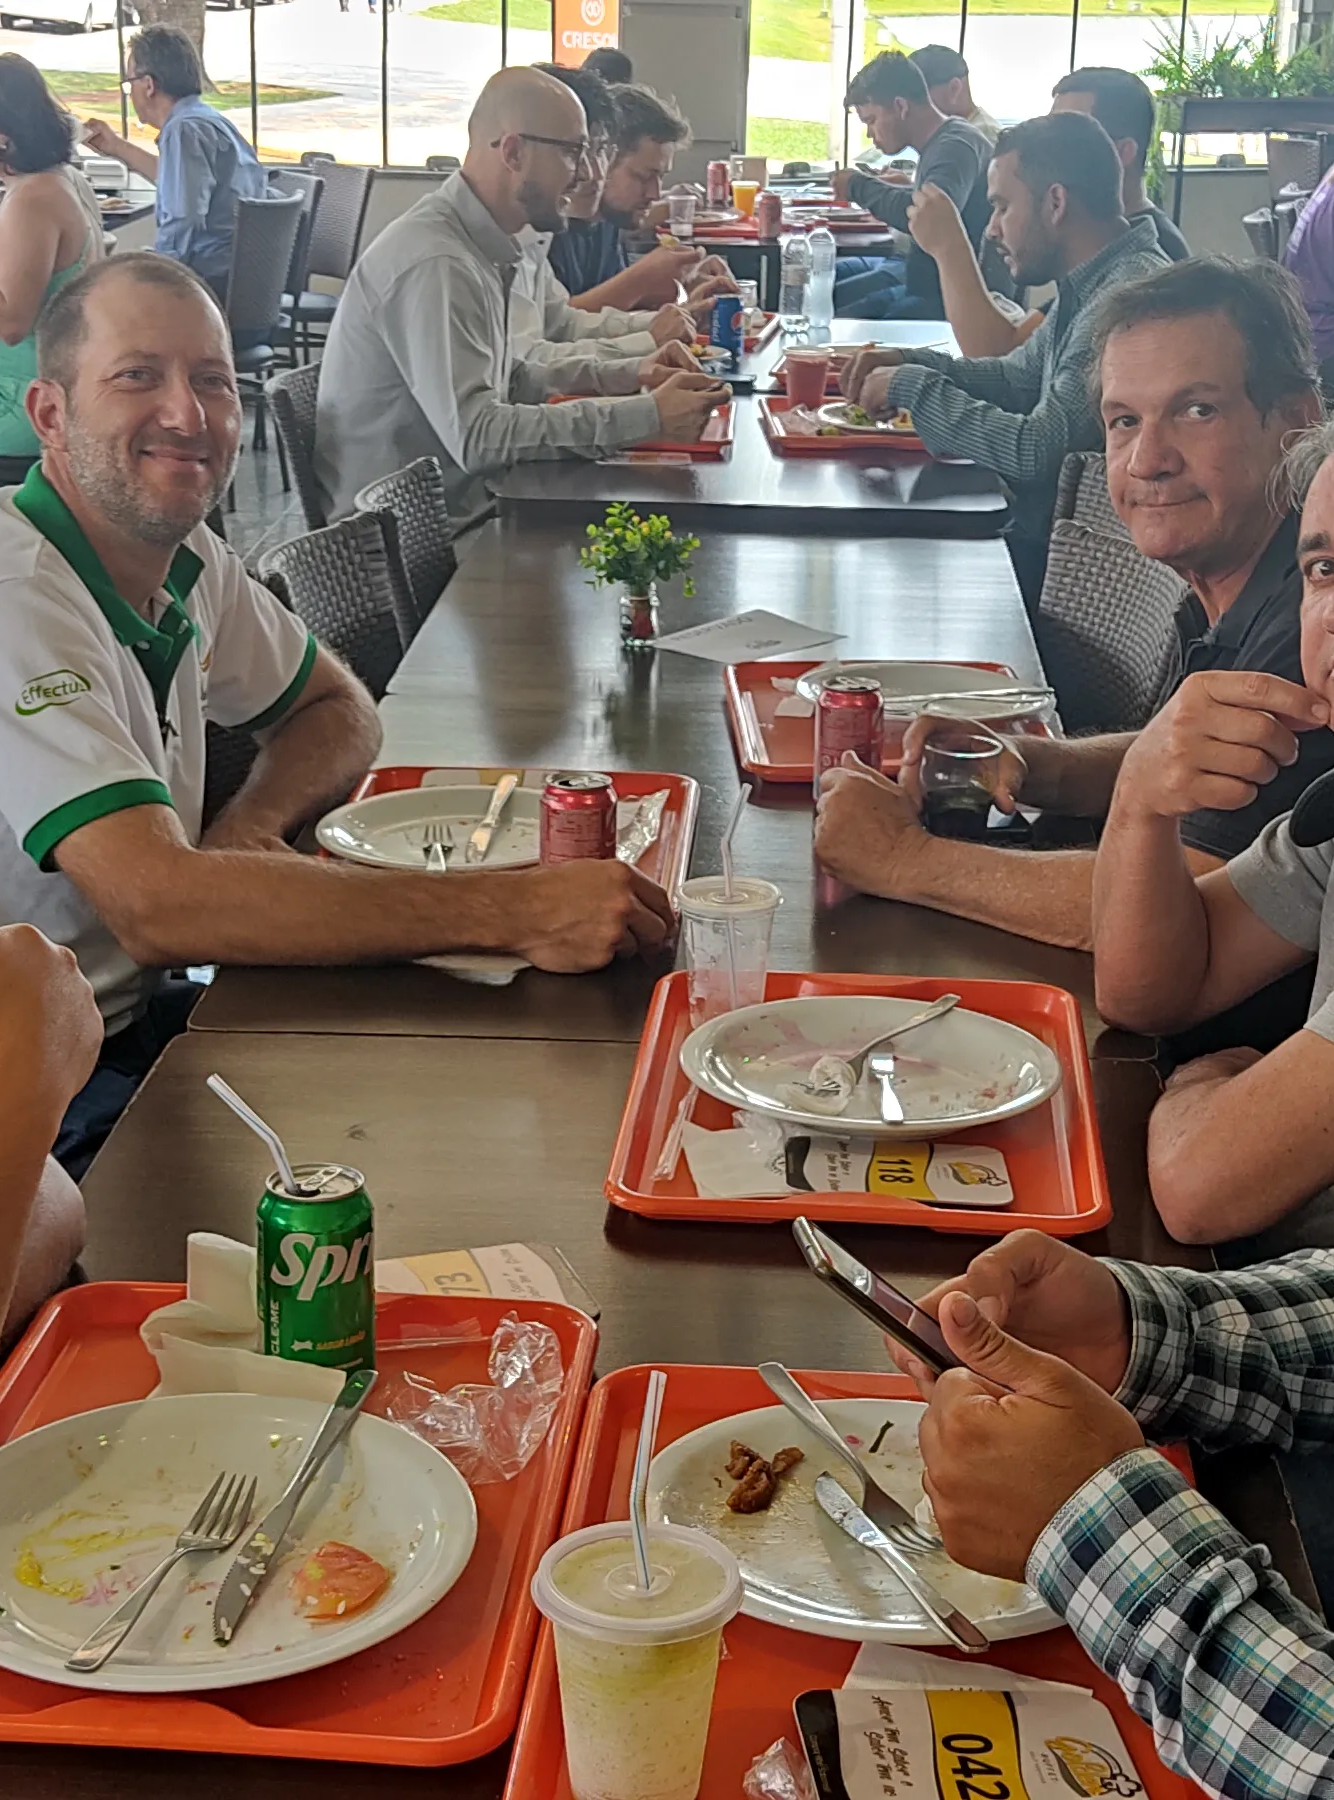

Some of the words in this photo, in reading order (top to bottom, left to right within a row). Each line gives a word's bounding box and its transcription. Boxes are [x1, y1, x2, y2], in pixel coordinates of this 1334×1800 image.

[876, 1157, 915, 1184] 118
[433, 1272, 481, 1295] 13
[269, 1300, 281, 1355] CLE-ME
[941, 1733, 1011, 1800] 042
